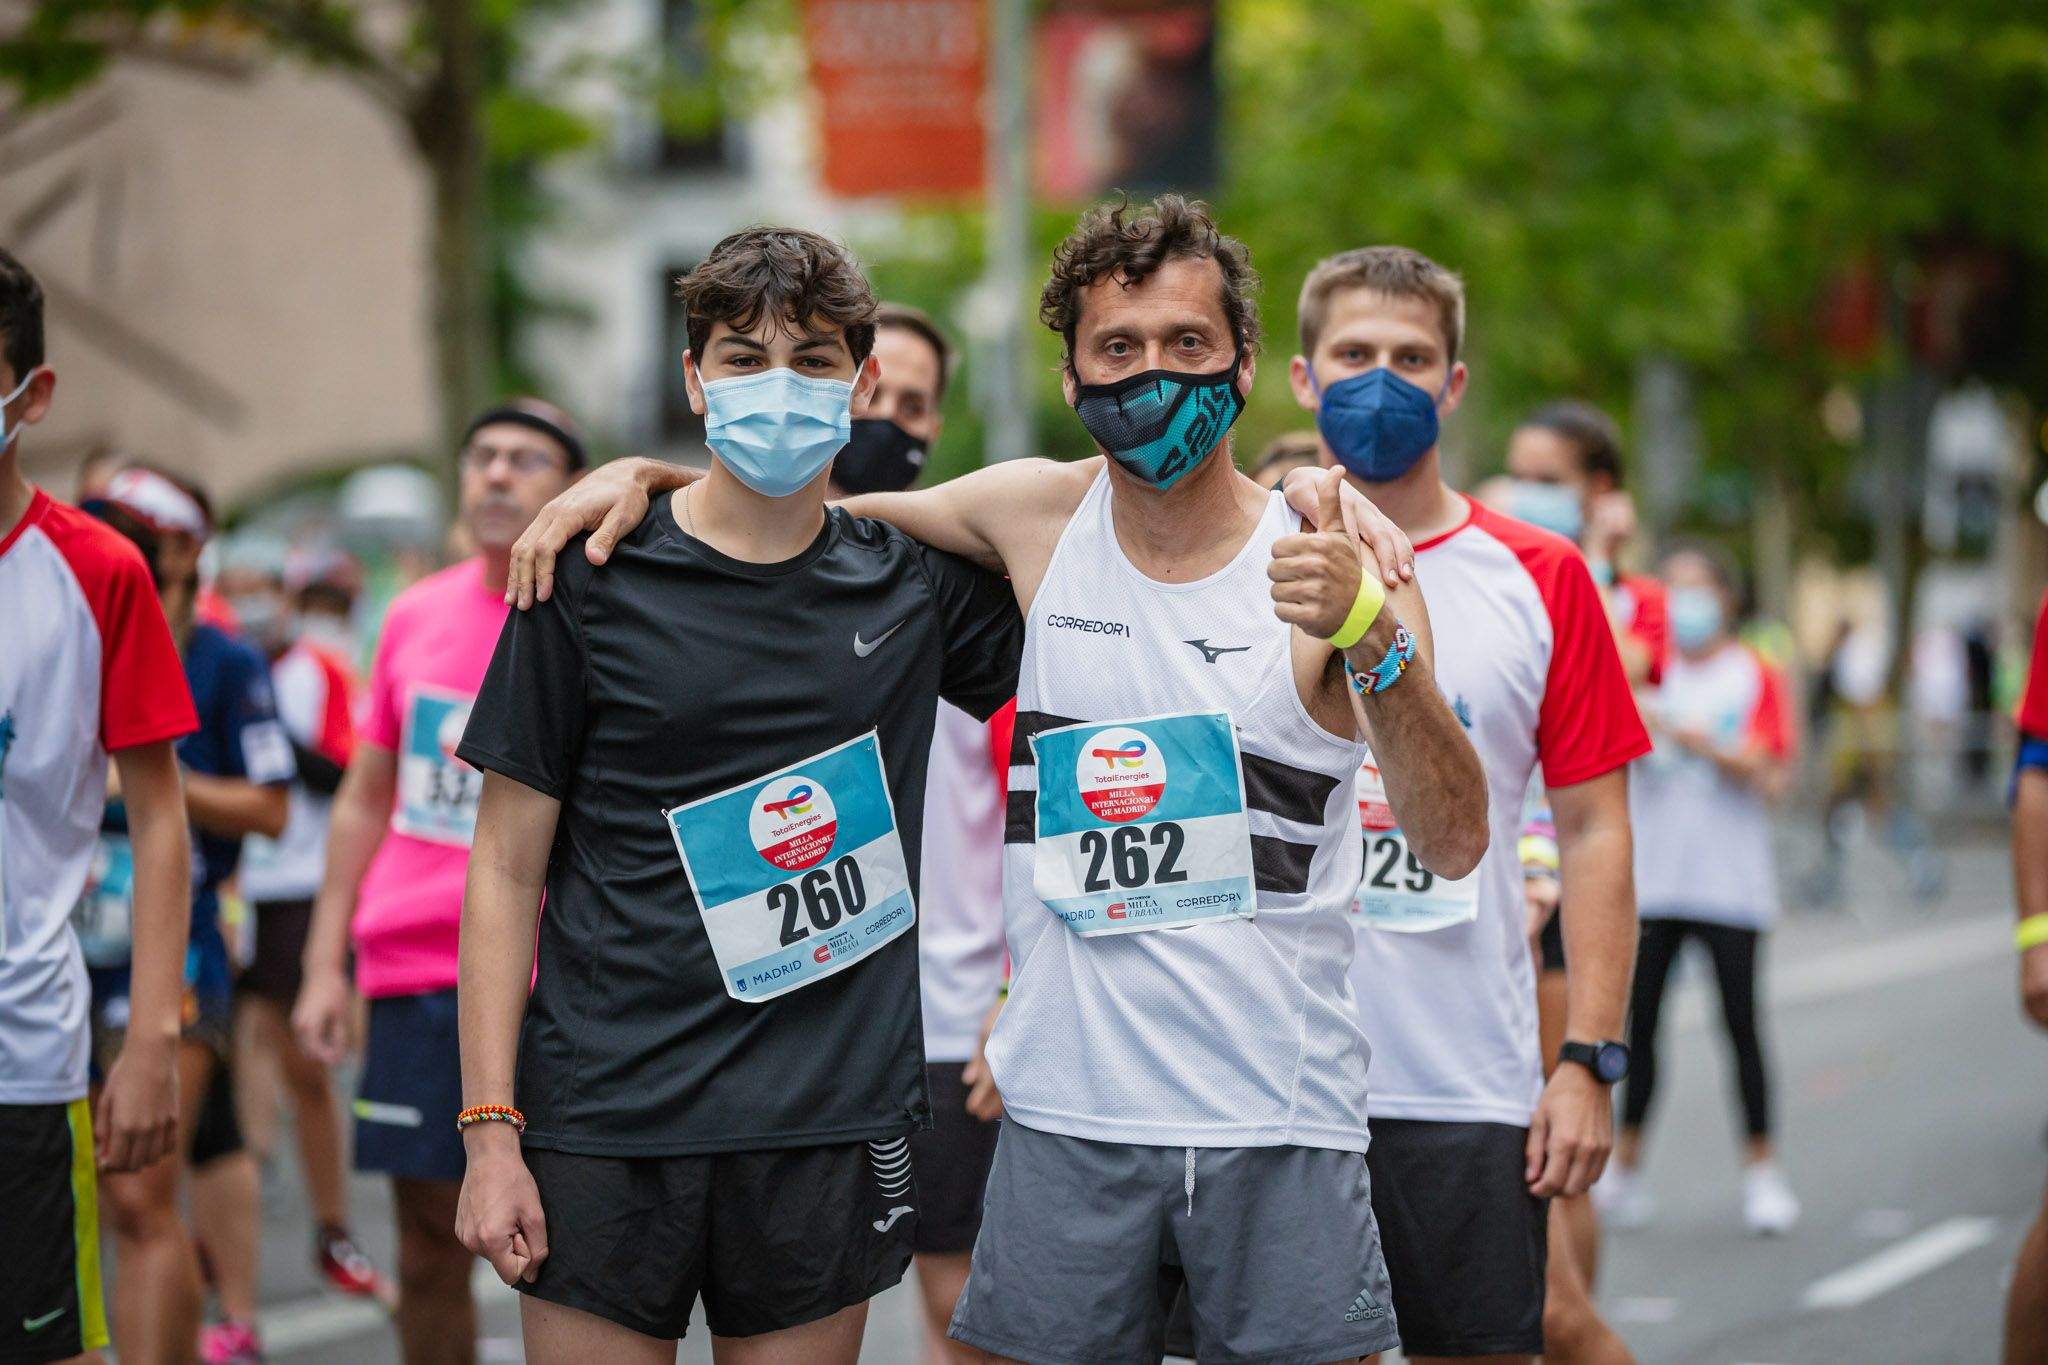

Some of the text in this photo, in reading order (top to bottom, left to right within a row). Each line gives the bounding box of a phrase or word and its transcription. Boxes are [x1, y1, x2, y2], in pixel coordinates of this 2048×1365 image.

[1094, 771, 1150, 784] TotalEnergies
[1109, 789, 1136, 799] MILLA
[1101, 805, 1147, 817] DE MADRID
[771, 813, 822, 838] TotalEnergies
[788, 834, 814, 849] MILLA
[785, 845, 827, 868] DE MADRID
[1080, 821, 1188, 893] 262
[1361, 836, 1434, 893] 29
[767, 854, 867, 948] 260
[1128, 900, 1158, 909] MILLA
[1128, 907, 1163, 918] URBANA
[829, 933, 855, 949] MILLA
[753, 960, 802, 985] MADRID
[1344, 1307, 1384, 1322] adidas
